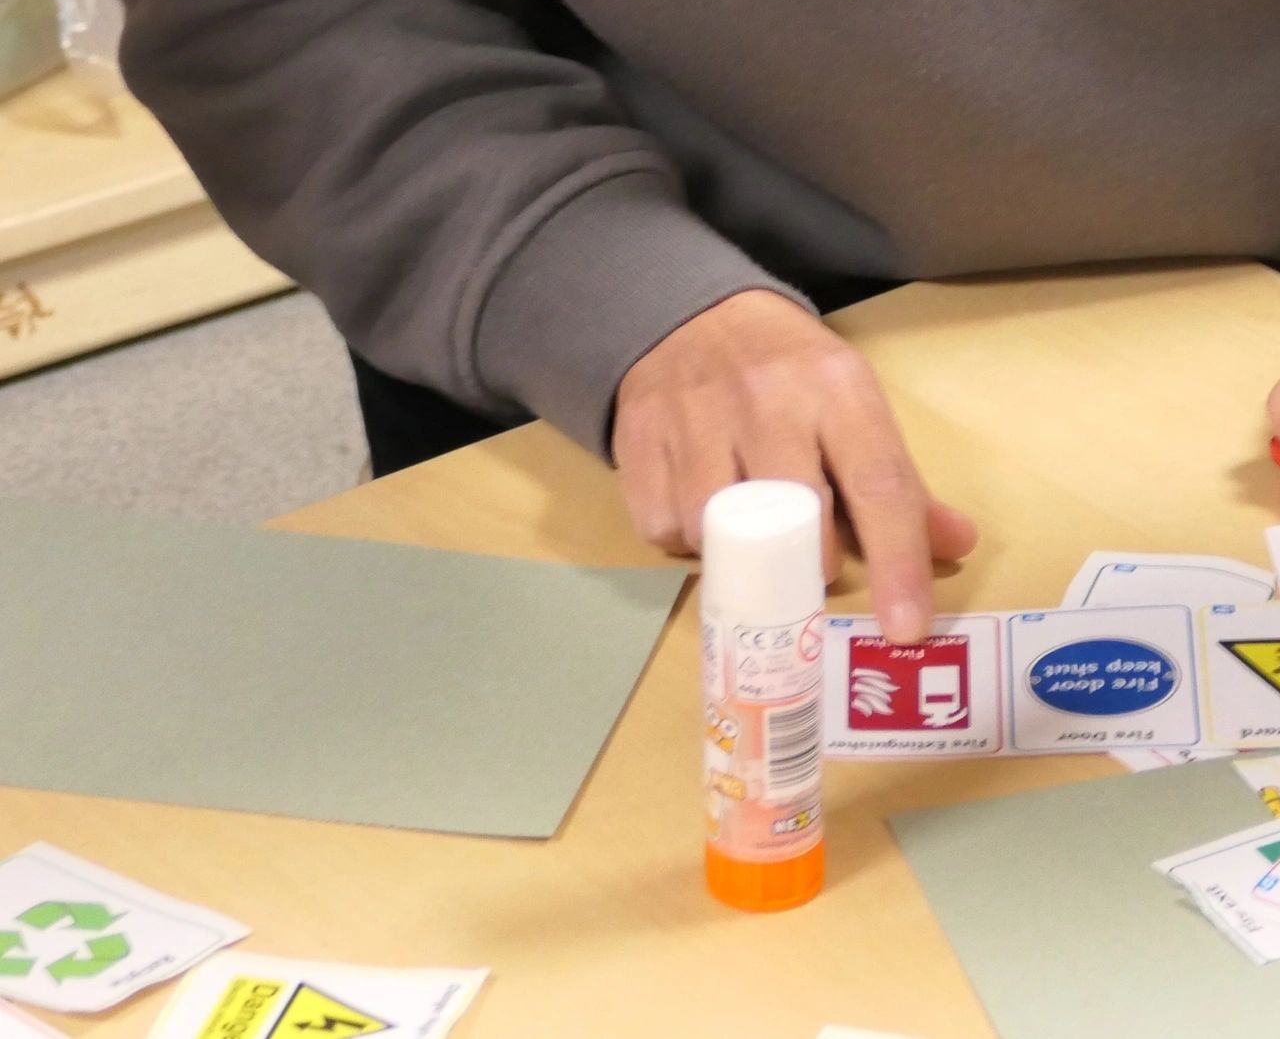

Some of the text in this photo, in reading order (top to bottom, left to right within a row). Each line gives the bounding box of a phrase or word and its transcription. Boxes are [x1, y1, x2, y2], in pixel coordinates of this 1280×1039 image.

[887, 649, 925, 660] Fire
[1043, 658, 1162, 677] keep shut
[1046, 677, 1159, 695] Fire door
[1055, 729, 1154, 742] Fire Door
[827, 737, 987, 752] Fire Extinguisher
